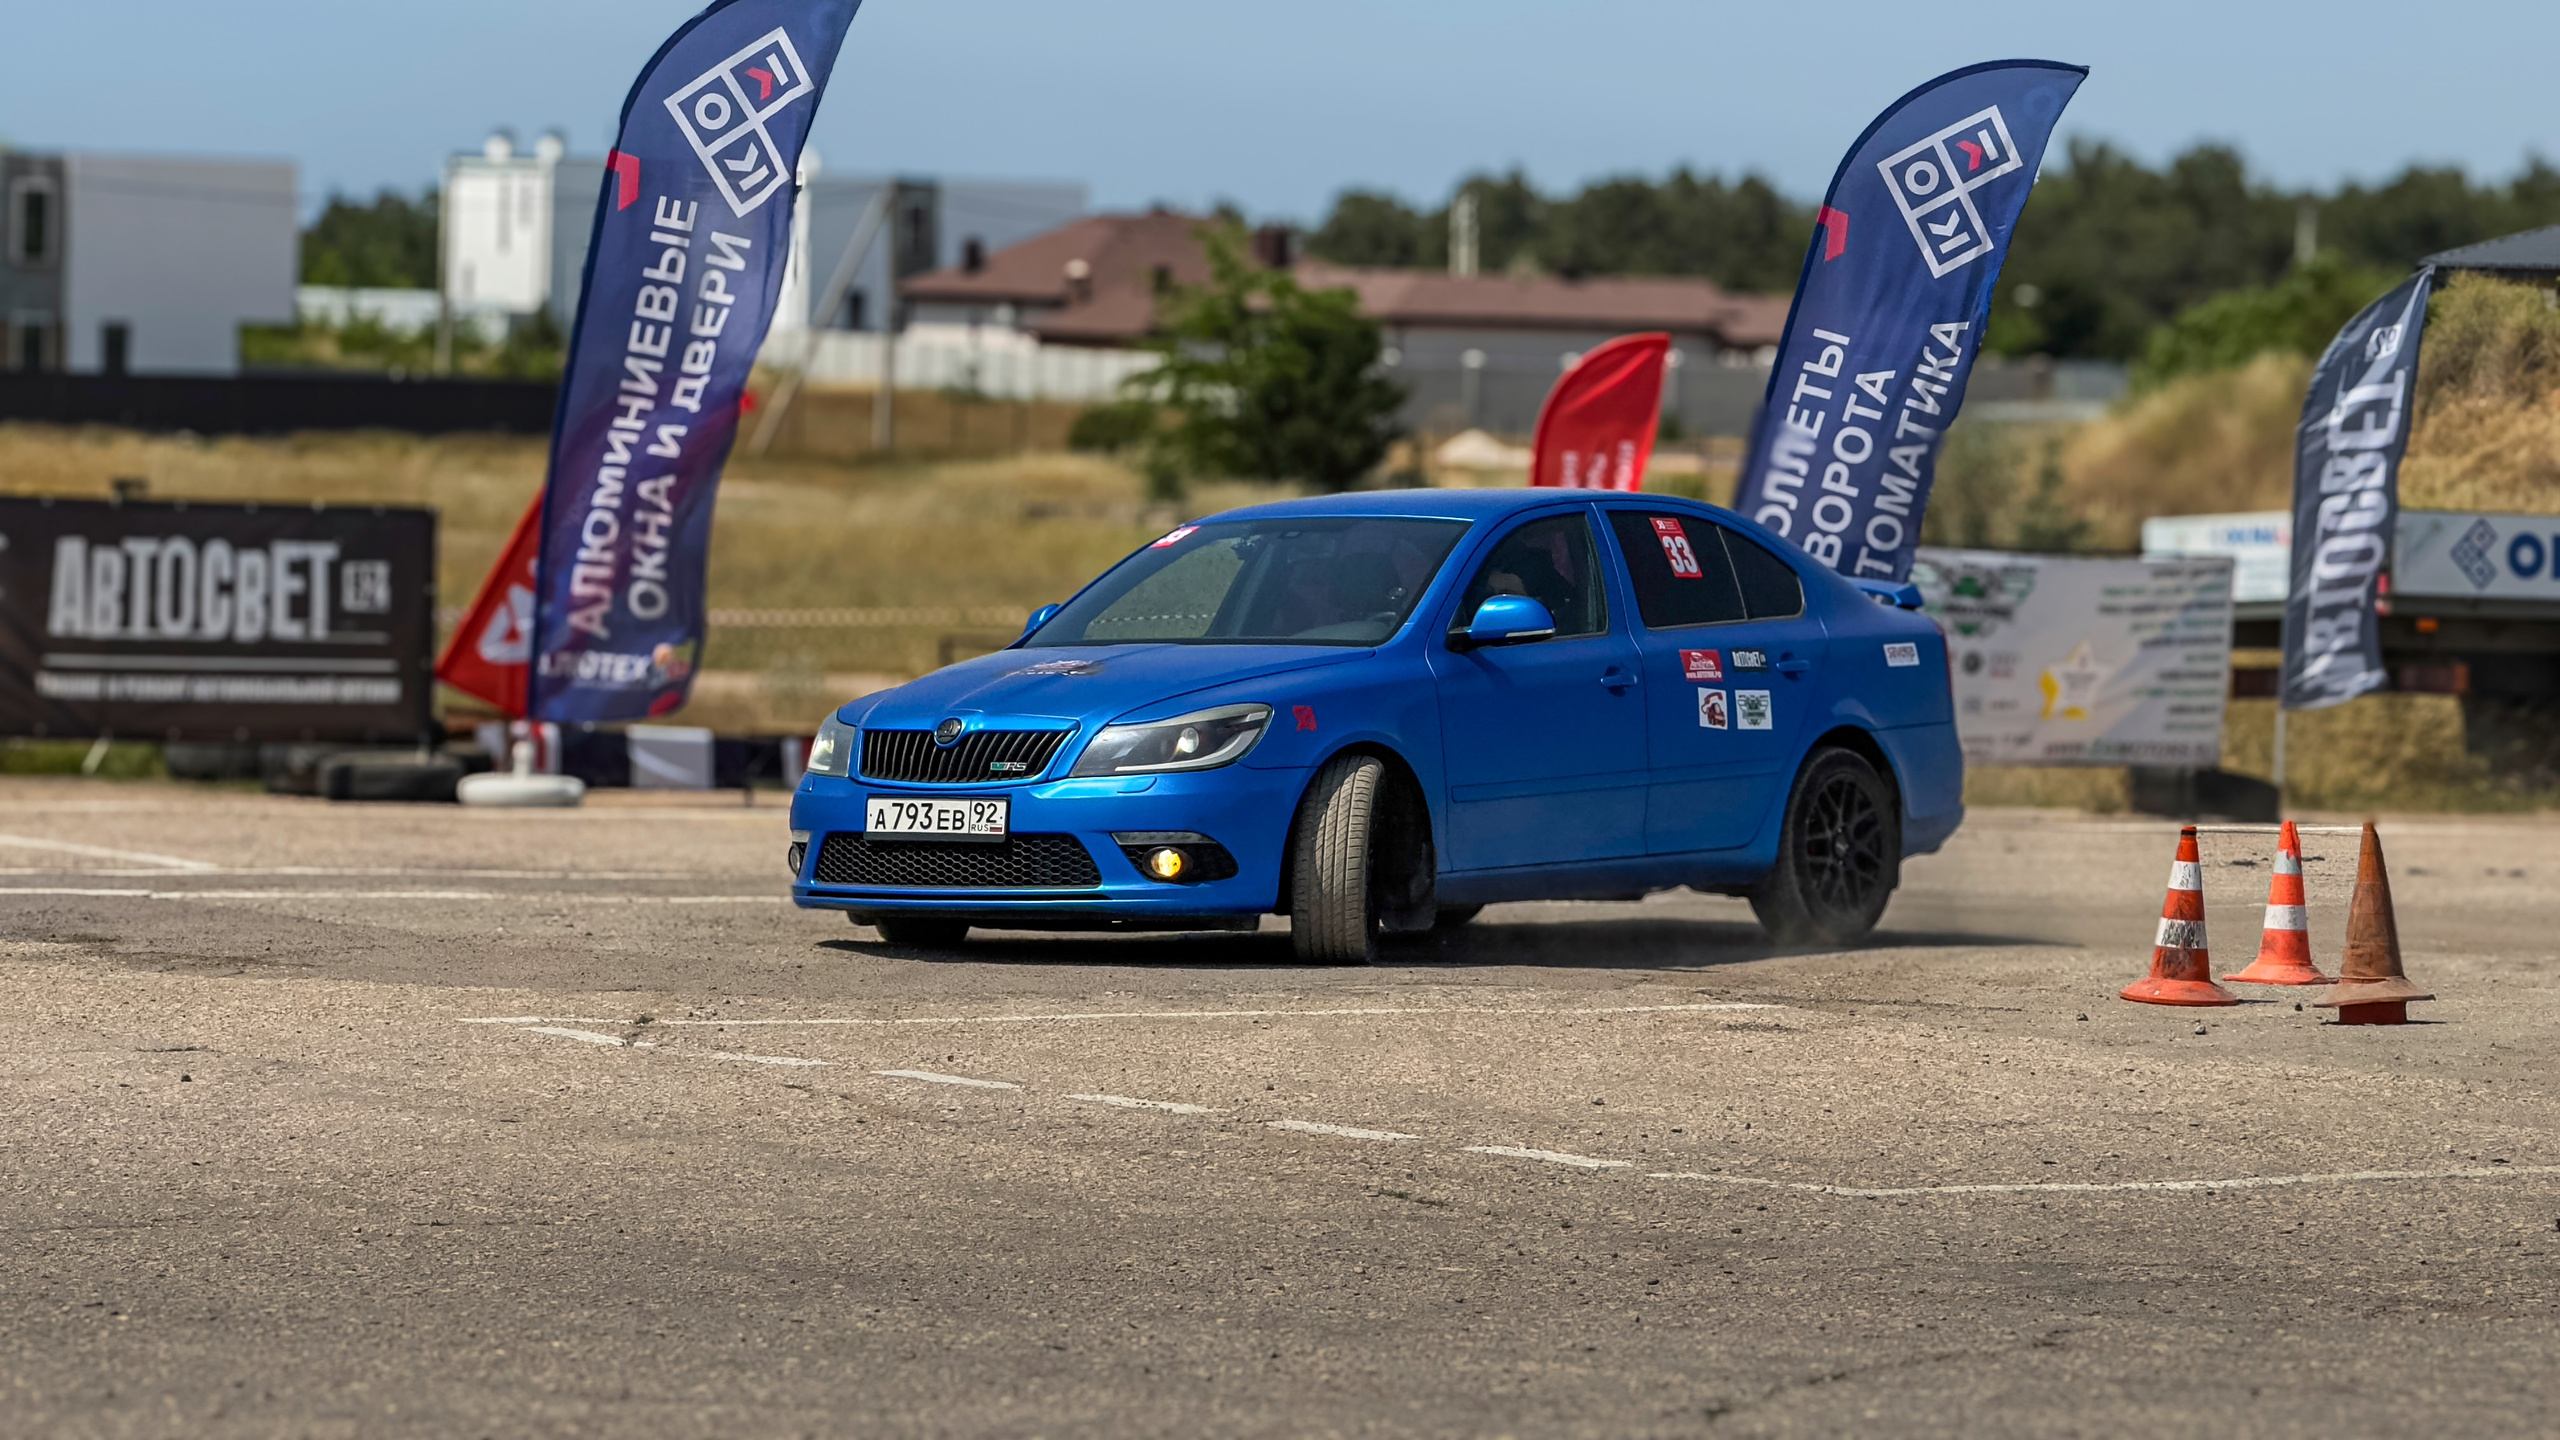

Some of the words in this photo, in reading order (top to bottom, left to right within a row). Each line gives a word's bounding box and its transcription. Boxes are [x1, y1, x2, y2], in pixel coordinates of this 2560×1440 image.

[670, 231, 752, 413] ДВЕРИ
[567, 195, 698, 640] АЛЮМИНИЕВЫЕ
[646, 424, 688, 459] И
[1754, 328, 1850, 539] ОЛЛЕТЫ
[1802, 369, 1896, 568] ВОРОТА
[1854, 321, 1969, 578] ТОМАТИКА
[628, 474, 677, 620] ОКНА
[1662, 535, 1698, 573] 33
[971, 824, 989, 832] RUS
[973, 802, 998, 824] 92
